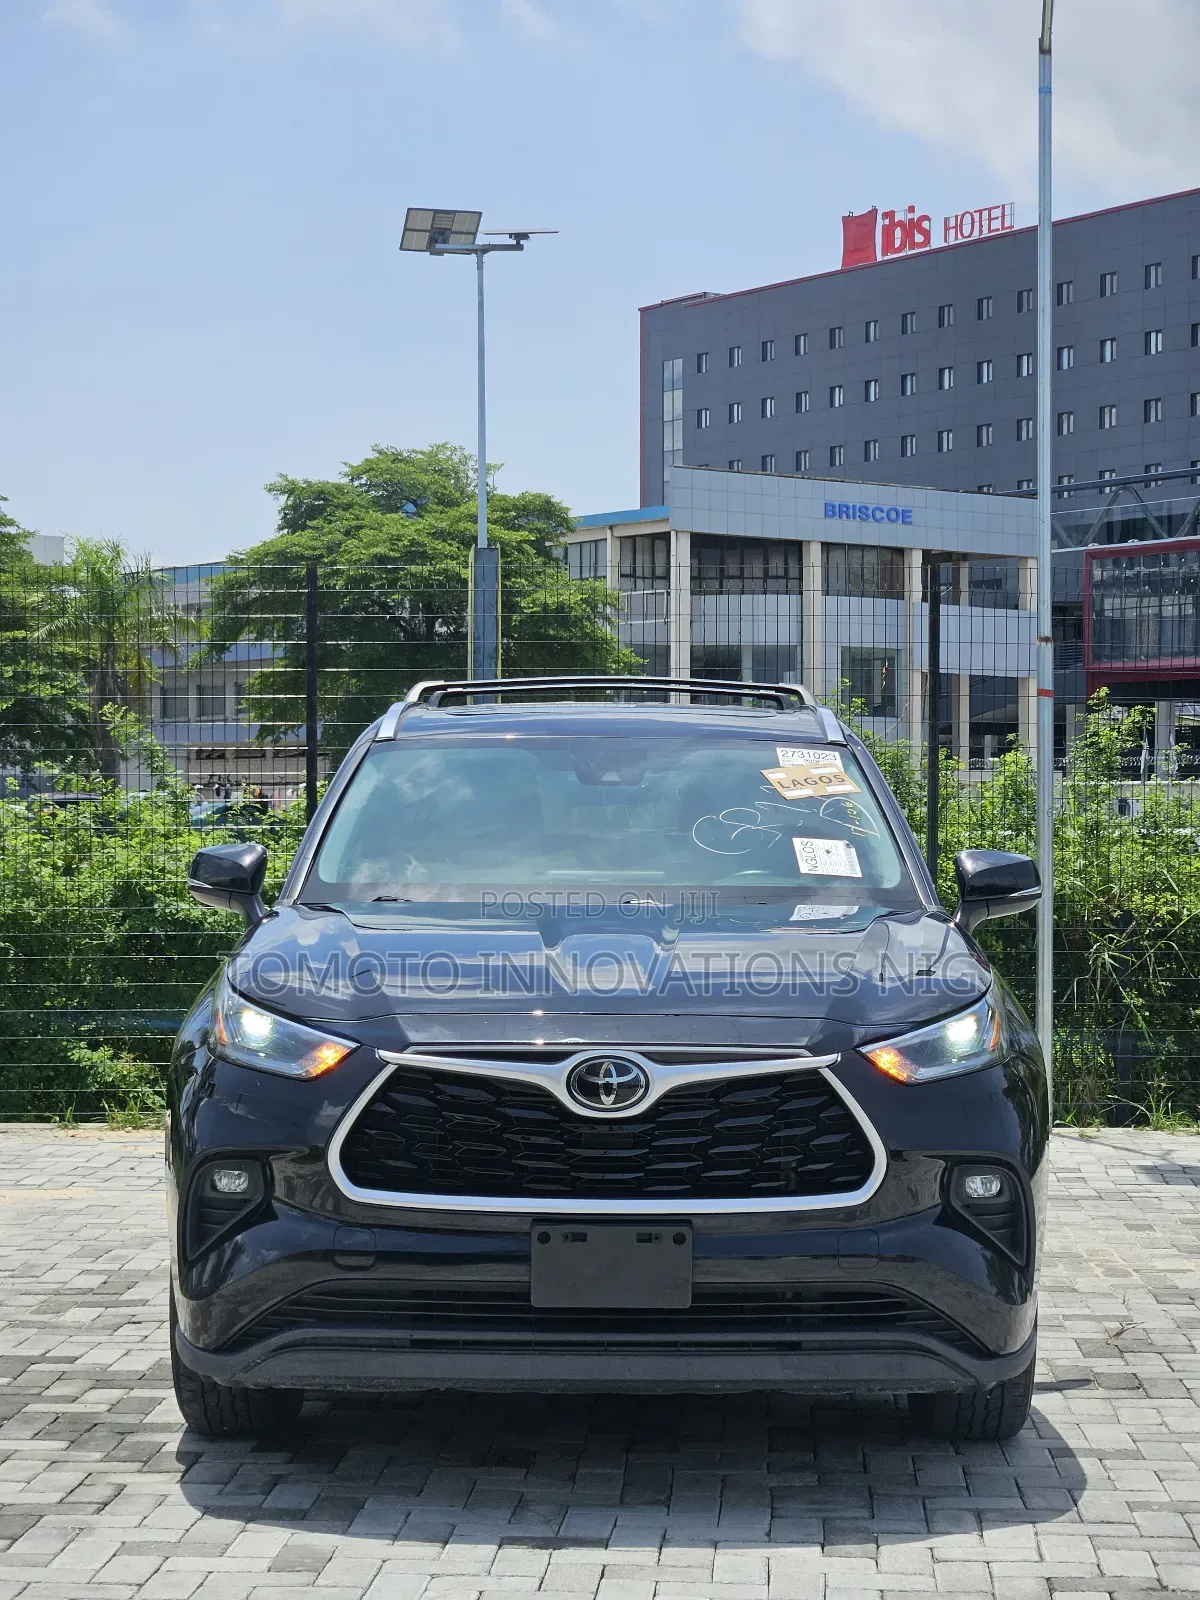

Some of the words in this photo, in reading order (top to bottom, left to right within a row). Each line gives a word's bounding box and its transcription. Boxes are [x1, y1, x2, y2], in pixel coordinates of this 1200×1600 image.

[881, 205, 931, 256] ibis
[943, 203, 1014, 244] HOTEL
[824, 502, 913, 525] BRISCOE
[781, 750, 837, 761] 2731023
[777, 775, 845, 789] LAGOS
[801, 840, 819, 872] NGLOS
